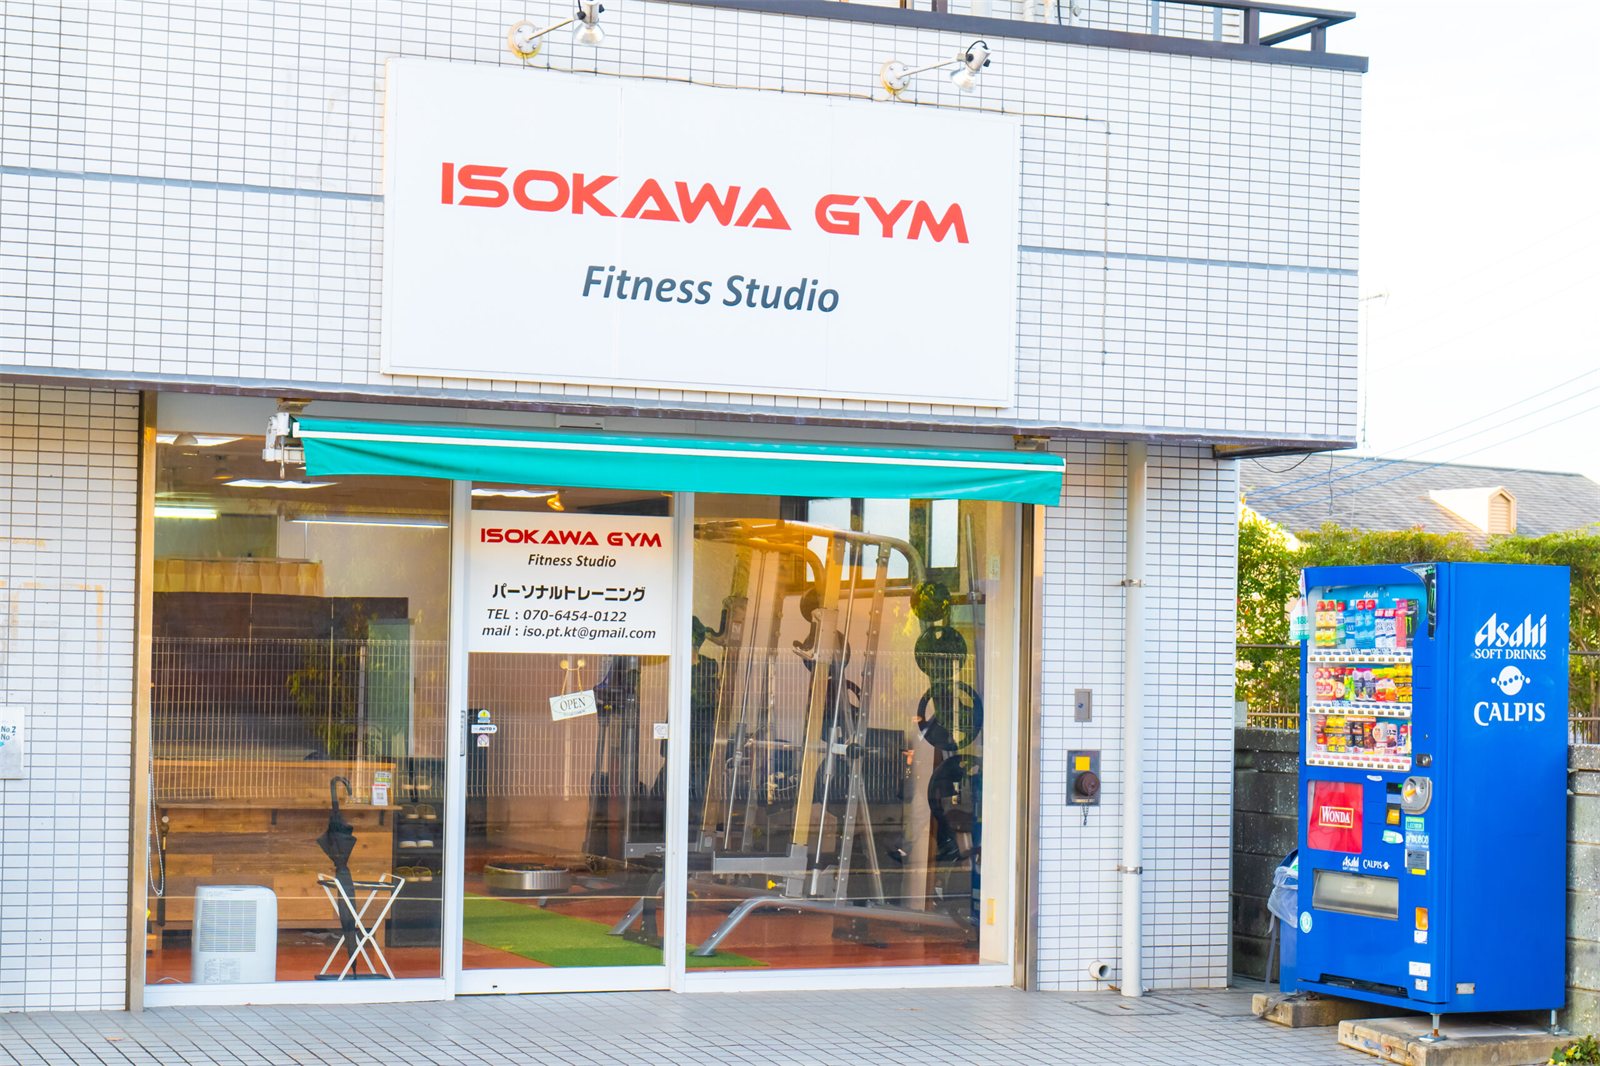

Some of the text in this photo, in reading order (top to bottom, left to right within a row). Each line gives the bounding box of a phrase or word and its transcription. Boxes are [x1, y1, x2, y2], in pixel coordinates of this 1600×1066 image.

[441, 161, 970, 244] ISOKAWA GYM
[582, 264, 840, 313] Fitness Studio
[481, 528, 662, 547] ISOKAWA GYM
[527, 554, 617, 568] Fitness Studio
[492, 582, 646, 602] パーソナルトレーニング
[487, 608, 510, 620] TEL
[523, 609, 627, 622] 070-6454-0122
[482, 625, 511, 637] mail
[522, 626, 656, 640] iso.pt.kt@gmail.com
[1474, 612, 1547, 648] Asahi
[1474, 648, 1547, 661] SOFT DRINKS
[560, 697, 586, 712] OPEN
[1473, 701, 1546, 727] CALPIS
[1320, 805, 1351, 824] WONDA
[1362, 859, 1383, 870] CALPIS
